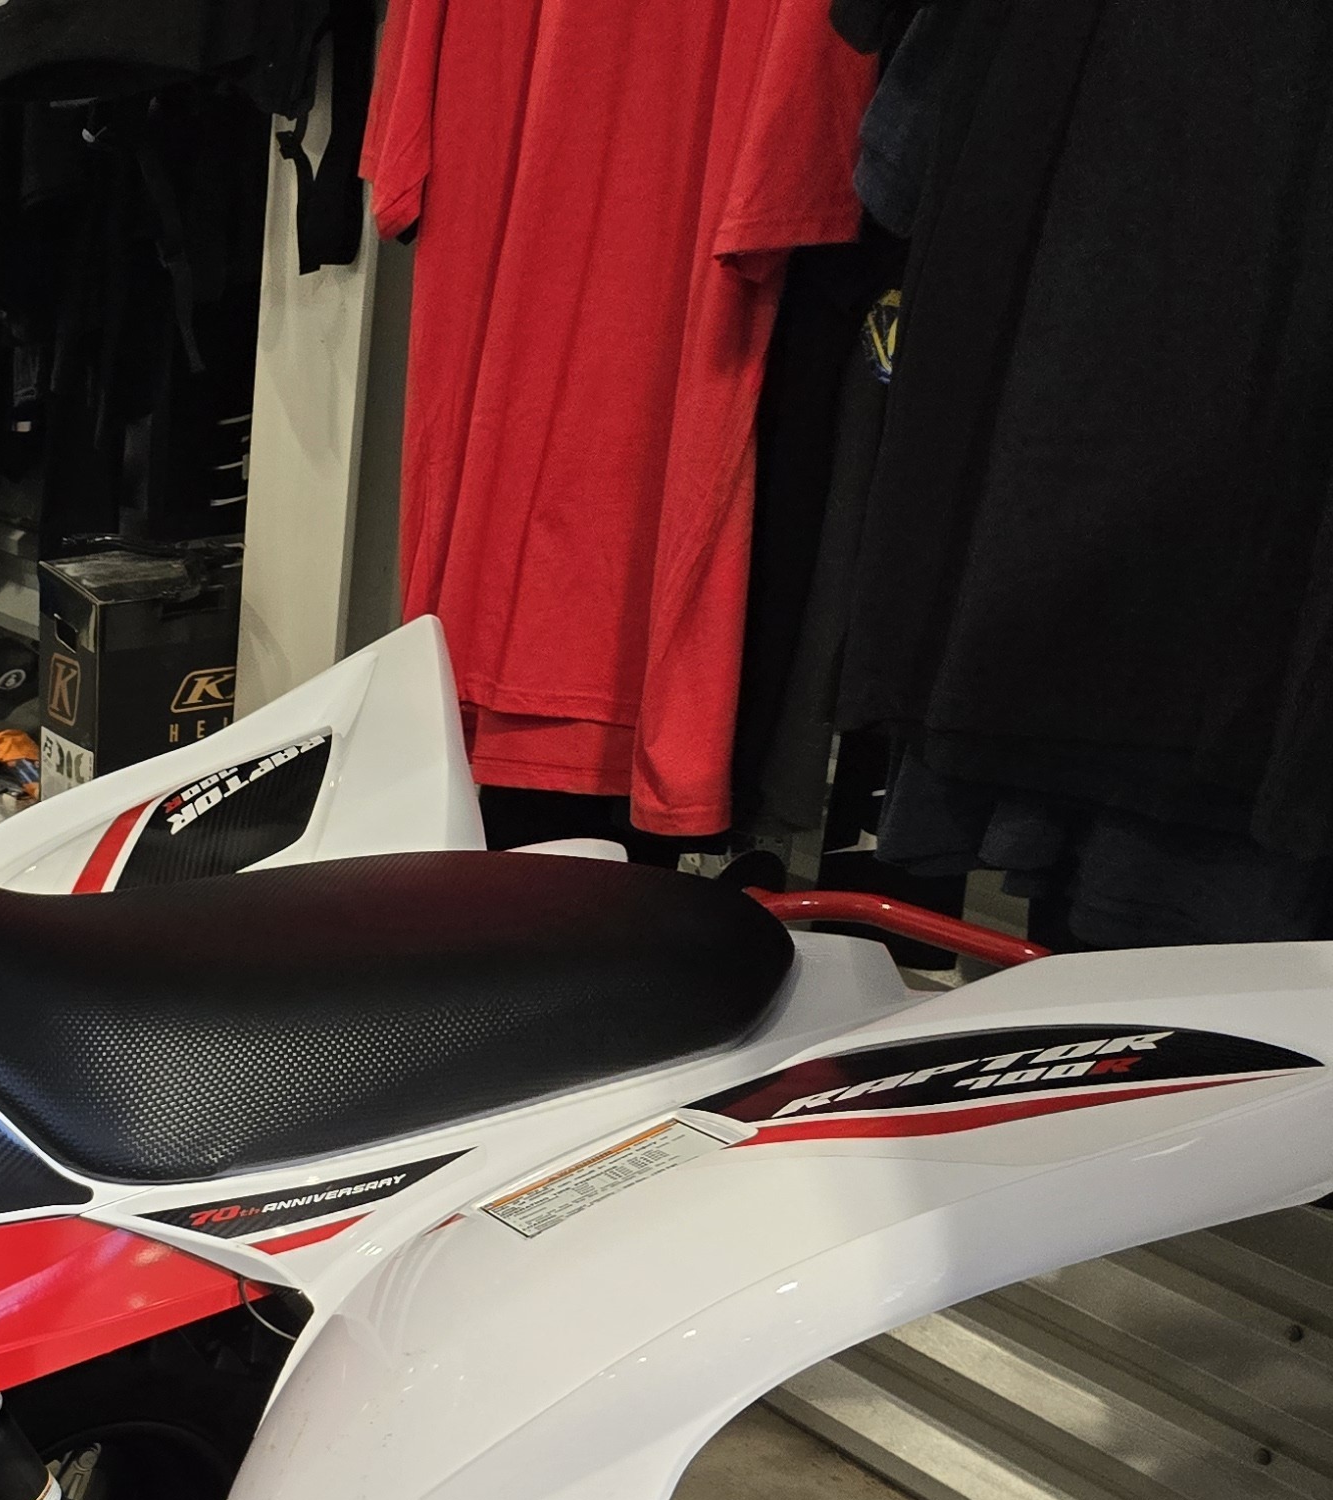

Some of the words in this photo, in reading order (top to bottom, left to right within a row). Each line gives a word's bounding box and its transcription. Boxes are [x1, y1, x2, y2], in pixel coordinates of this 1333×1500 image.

[51, 661, 78, 718] K
[181, 673, 235, 706] K
[166, 735, 326, 836] RAPTOR
[771, 1030, 1176, 1119] RAPTOR
[954, 1056, 1143, 1091] 700R
[189, 1201, 261, 1227] 70th
[261, 1172, 408, 1214] ANNIVERSARY
